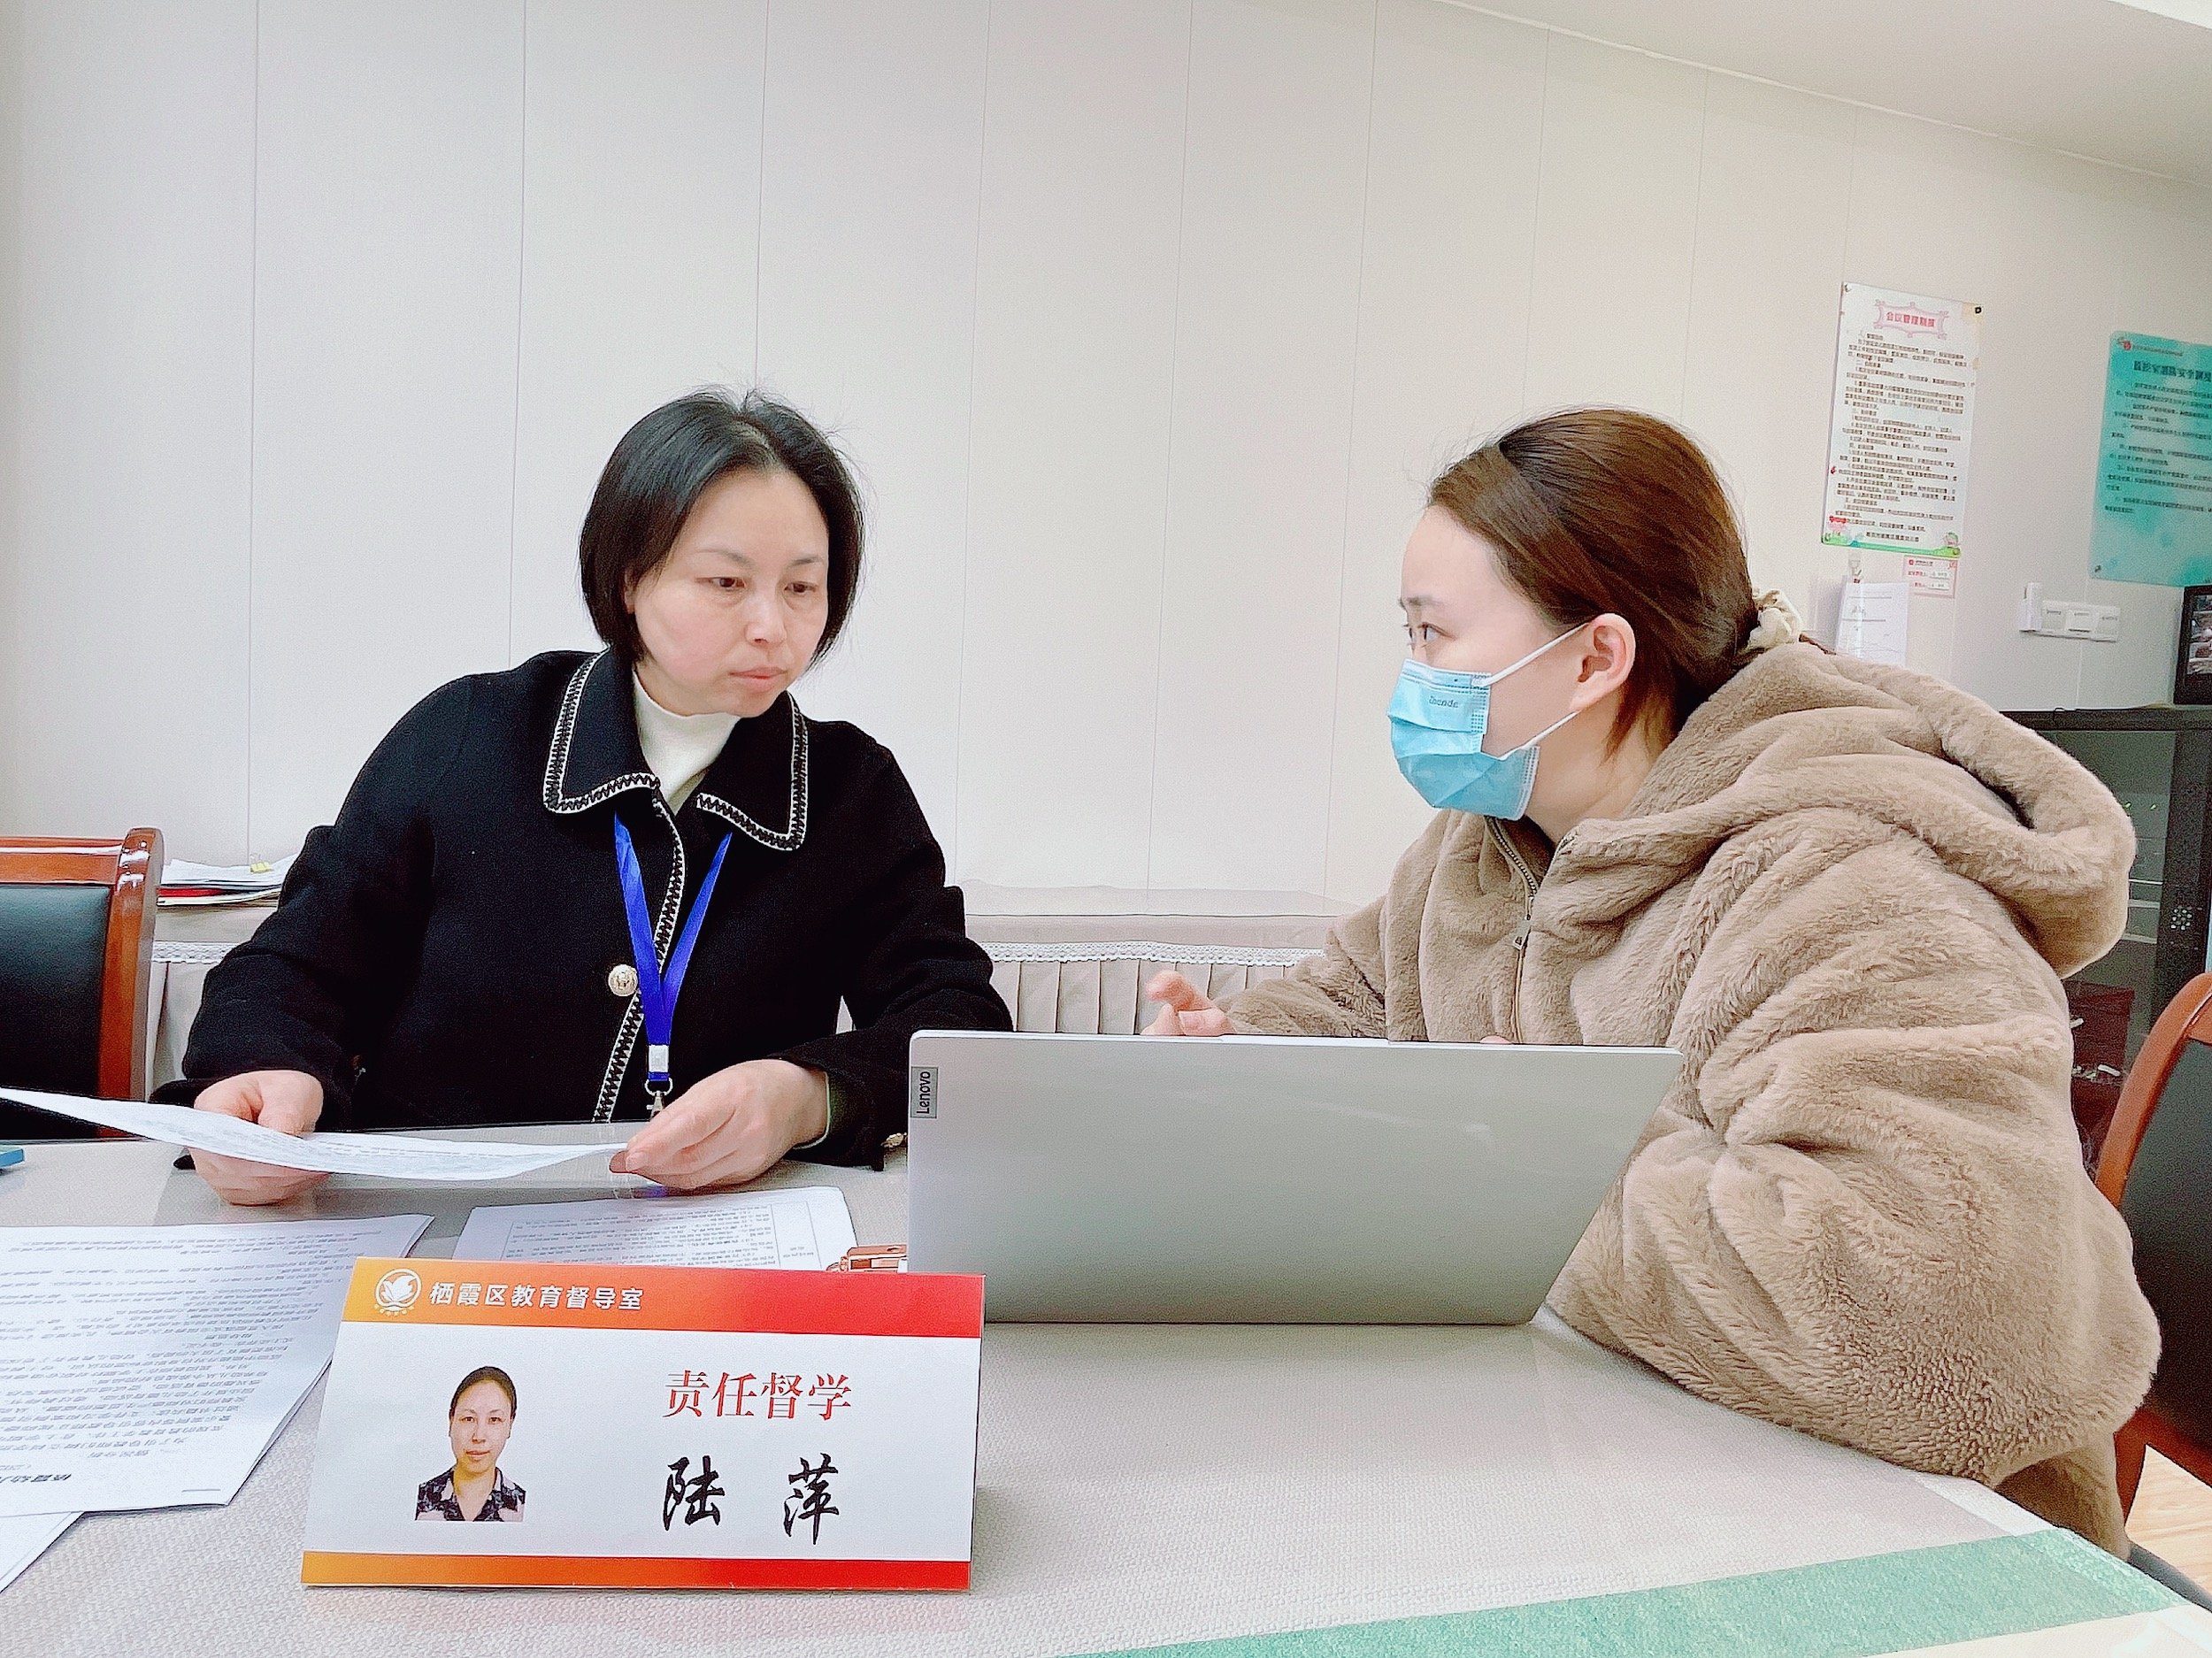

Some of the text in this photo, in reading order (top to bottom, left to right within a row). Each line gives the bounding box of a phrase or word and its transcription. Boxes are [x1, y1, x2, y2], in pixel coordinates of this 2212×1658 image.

[916, 1071, 931, 1115] Lenovo
[428, 1281, 644, 1312] 栖霞区教育督导室
[664, 1370, 852, 1421] 责任督学
[662, 1452, 841, 1546] 陆 萍
